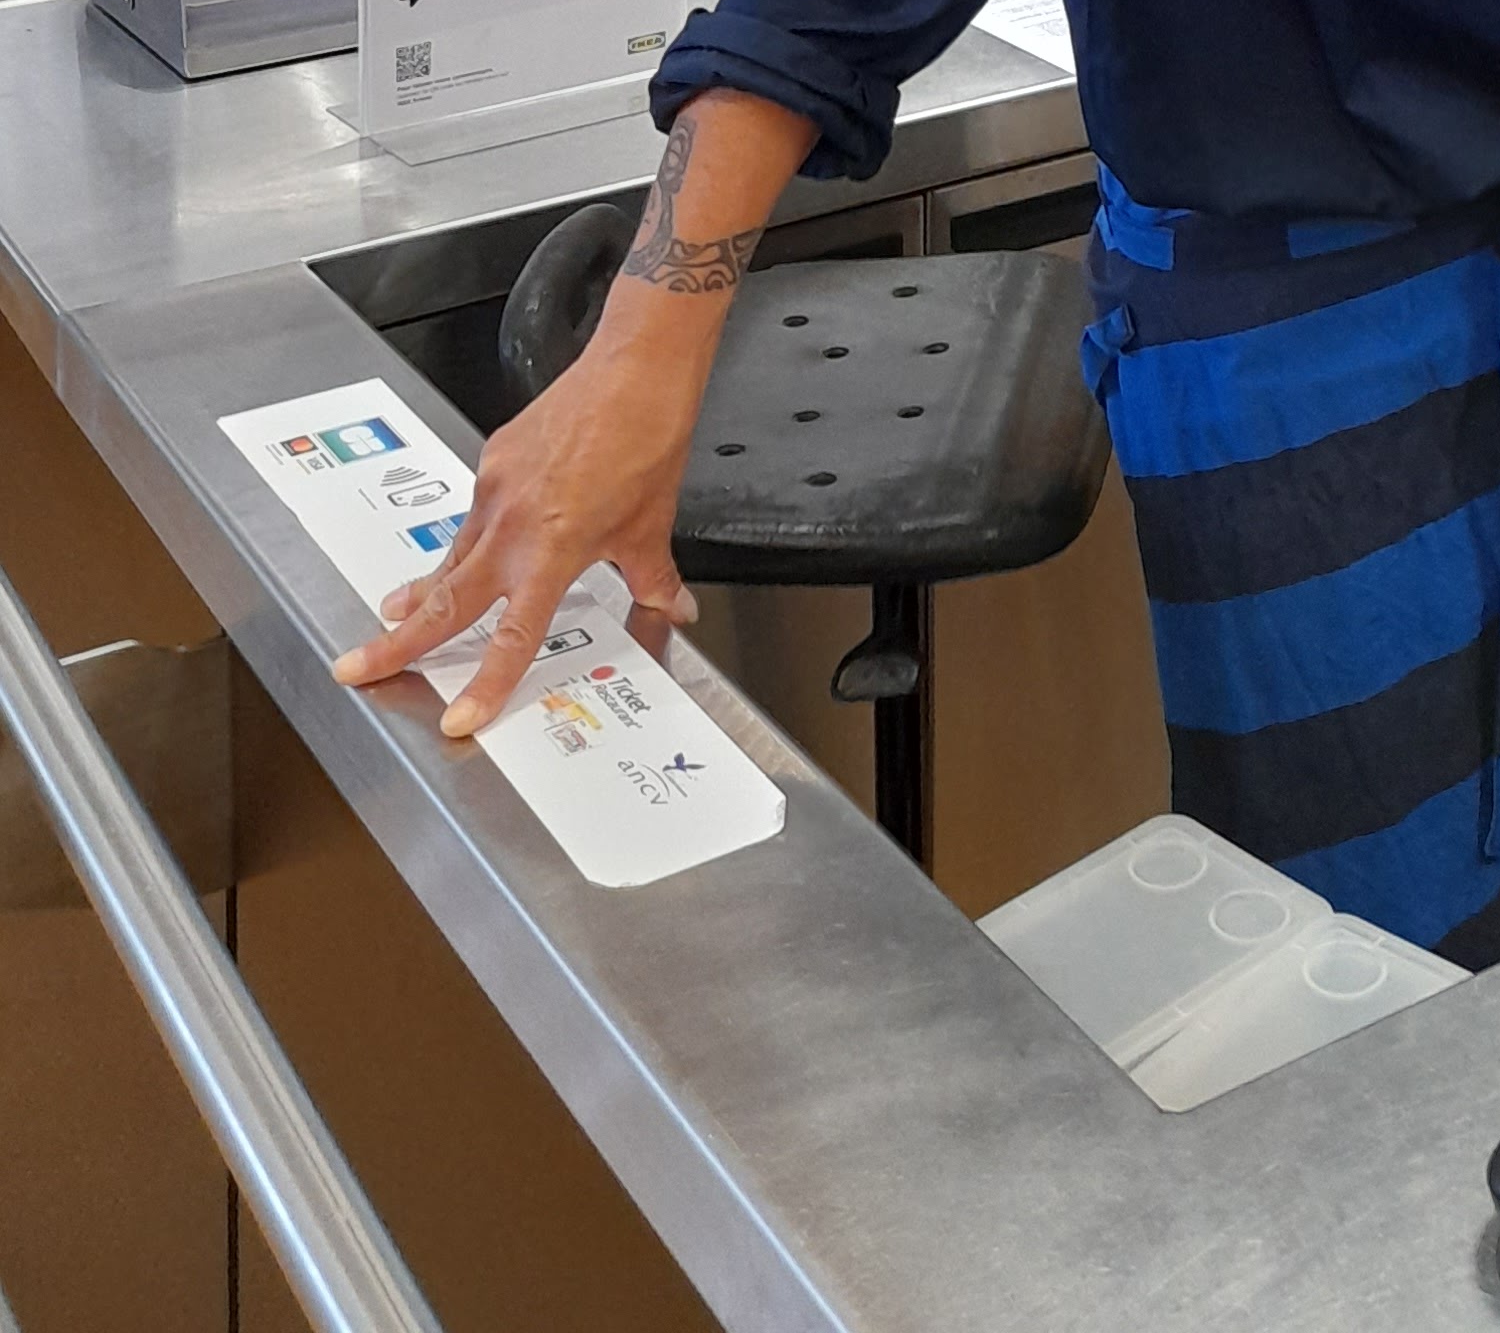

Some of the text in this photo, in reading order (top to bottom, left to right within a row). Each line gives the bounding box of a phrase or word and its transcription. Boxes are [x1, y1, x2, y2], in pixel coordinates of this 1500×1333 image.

[629, 34, 665, 52] IKEA
[608, 676, 652, 714] Ticket
[617, 760, 668, 805] ancv
